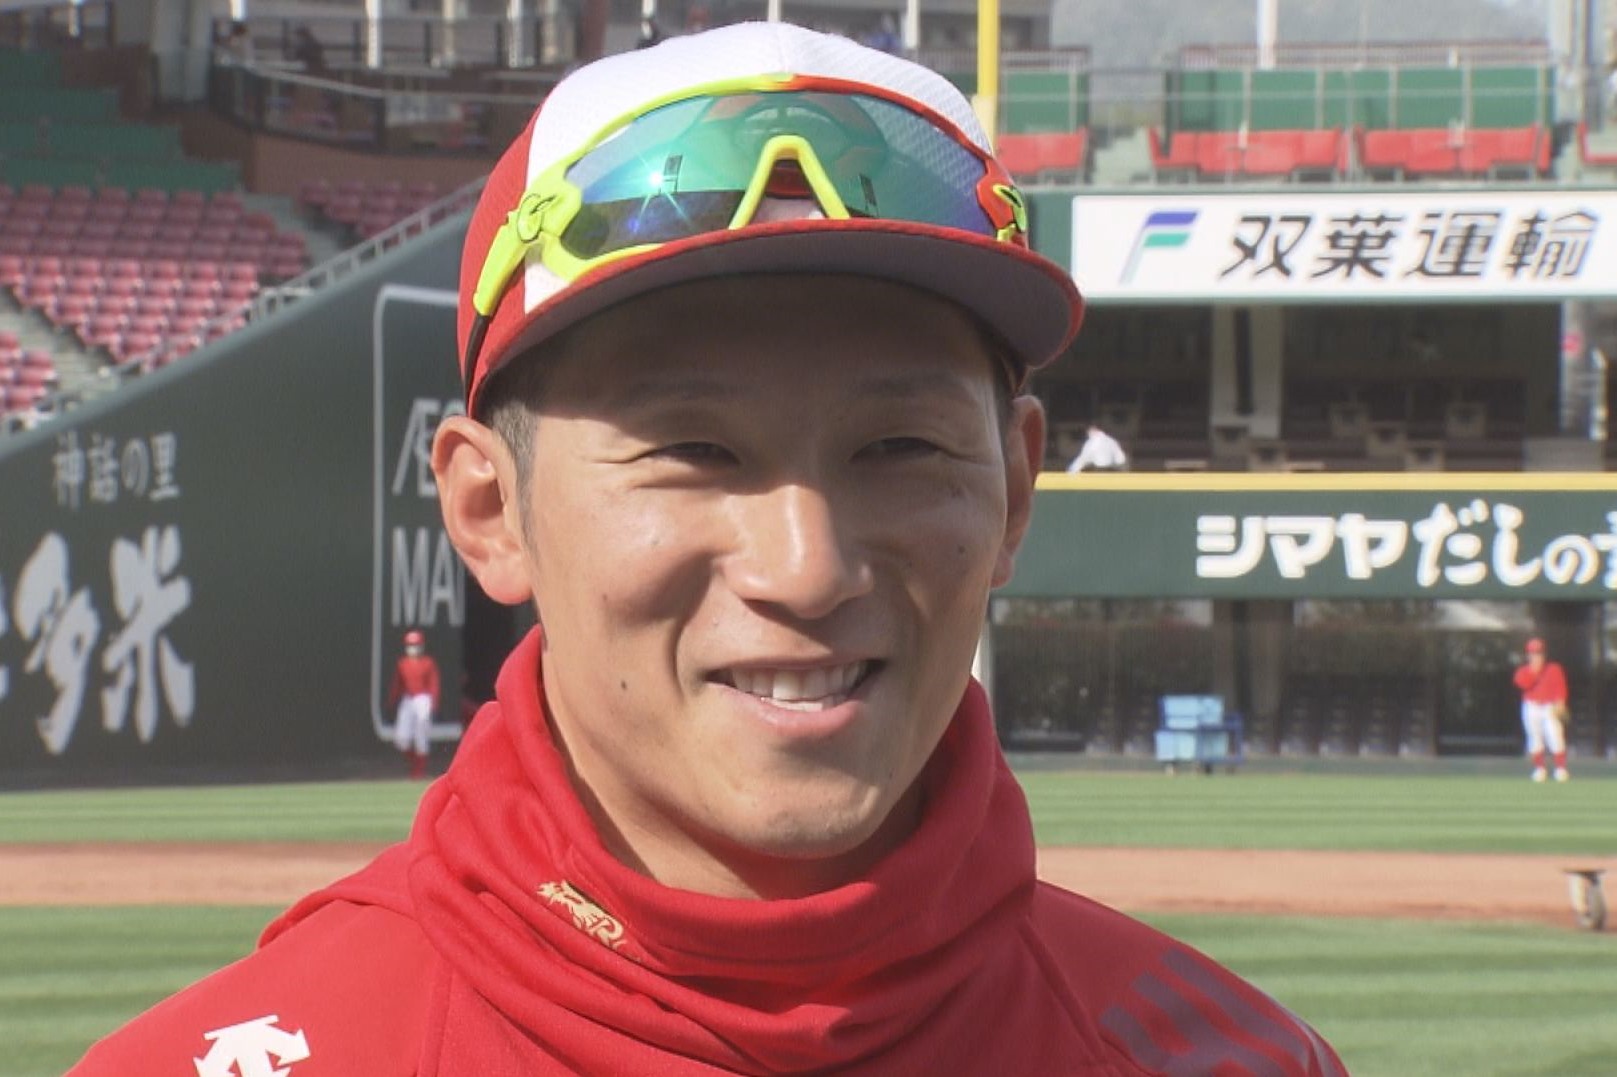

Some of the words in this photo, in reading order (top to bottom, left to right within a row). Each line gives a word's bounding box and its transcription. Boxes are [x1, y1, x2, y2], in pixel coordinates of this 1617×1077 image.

[1217, 208, 1600, 281] 双葉運輸
[52, 432, 182, 509] 神話の里
[1196, 499, 1617, 589] シマヤだしの
[0, 525, 196, 755] 多米
